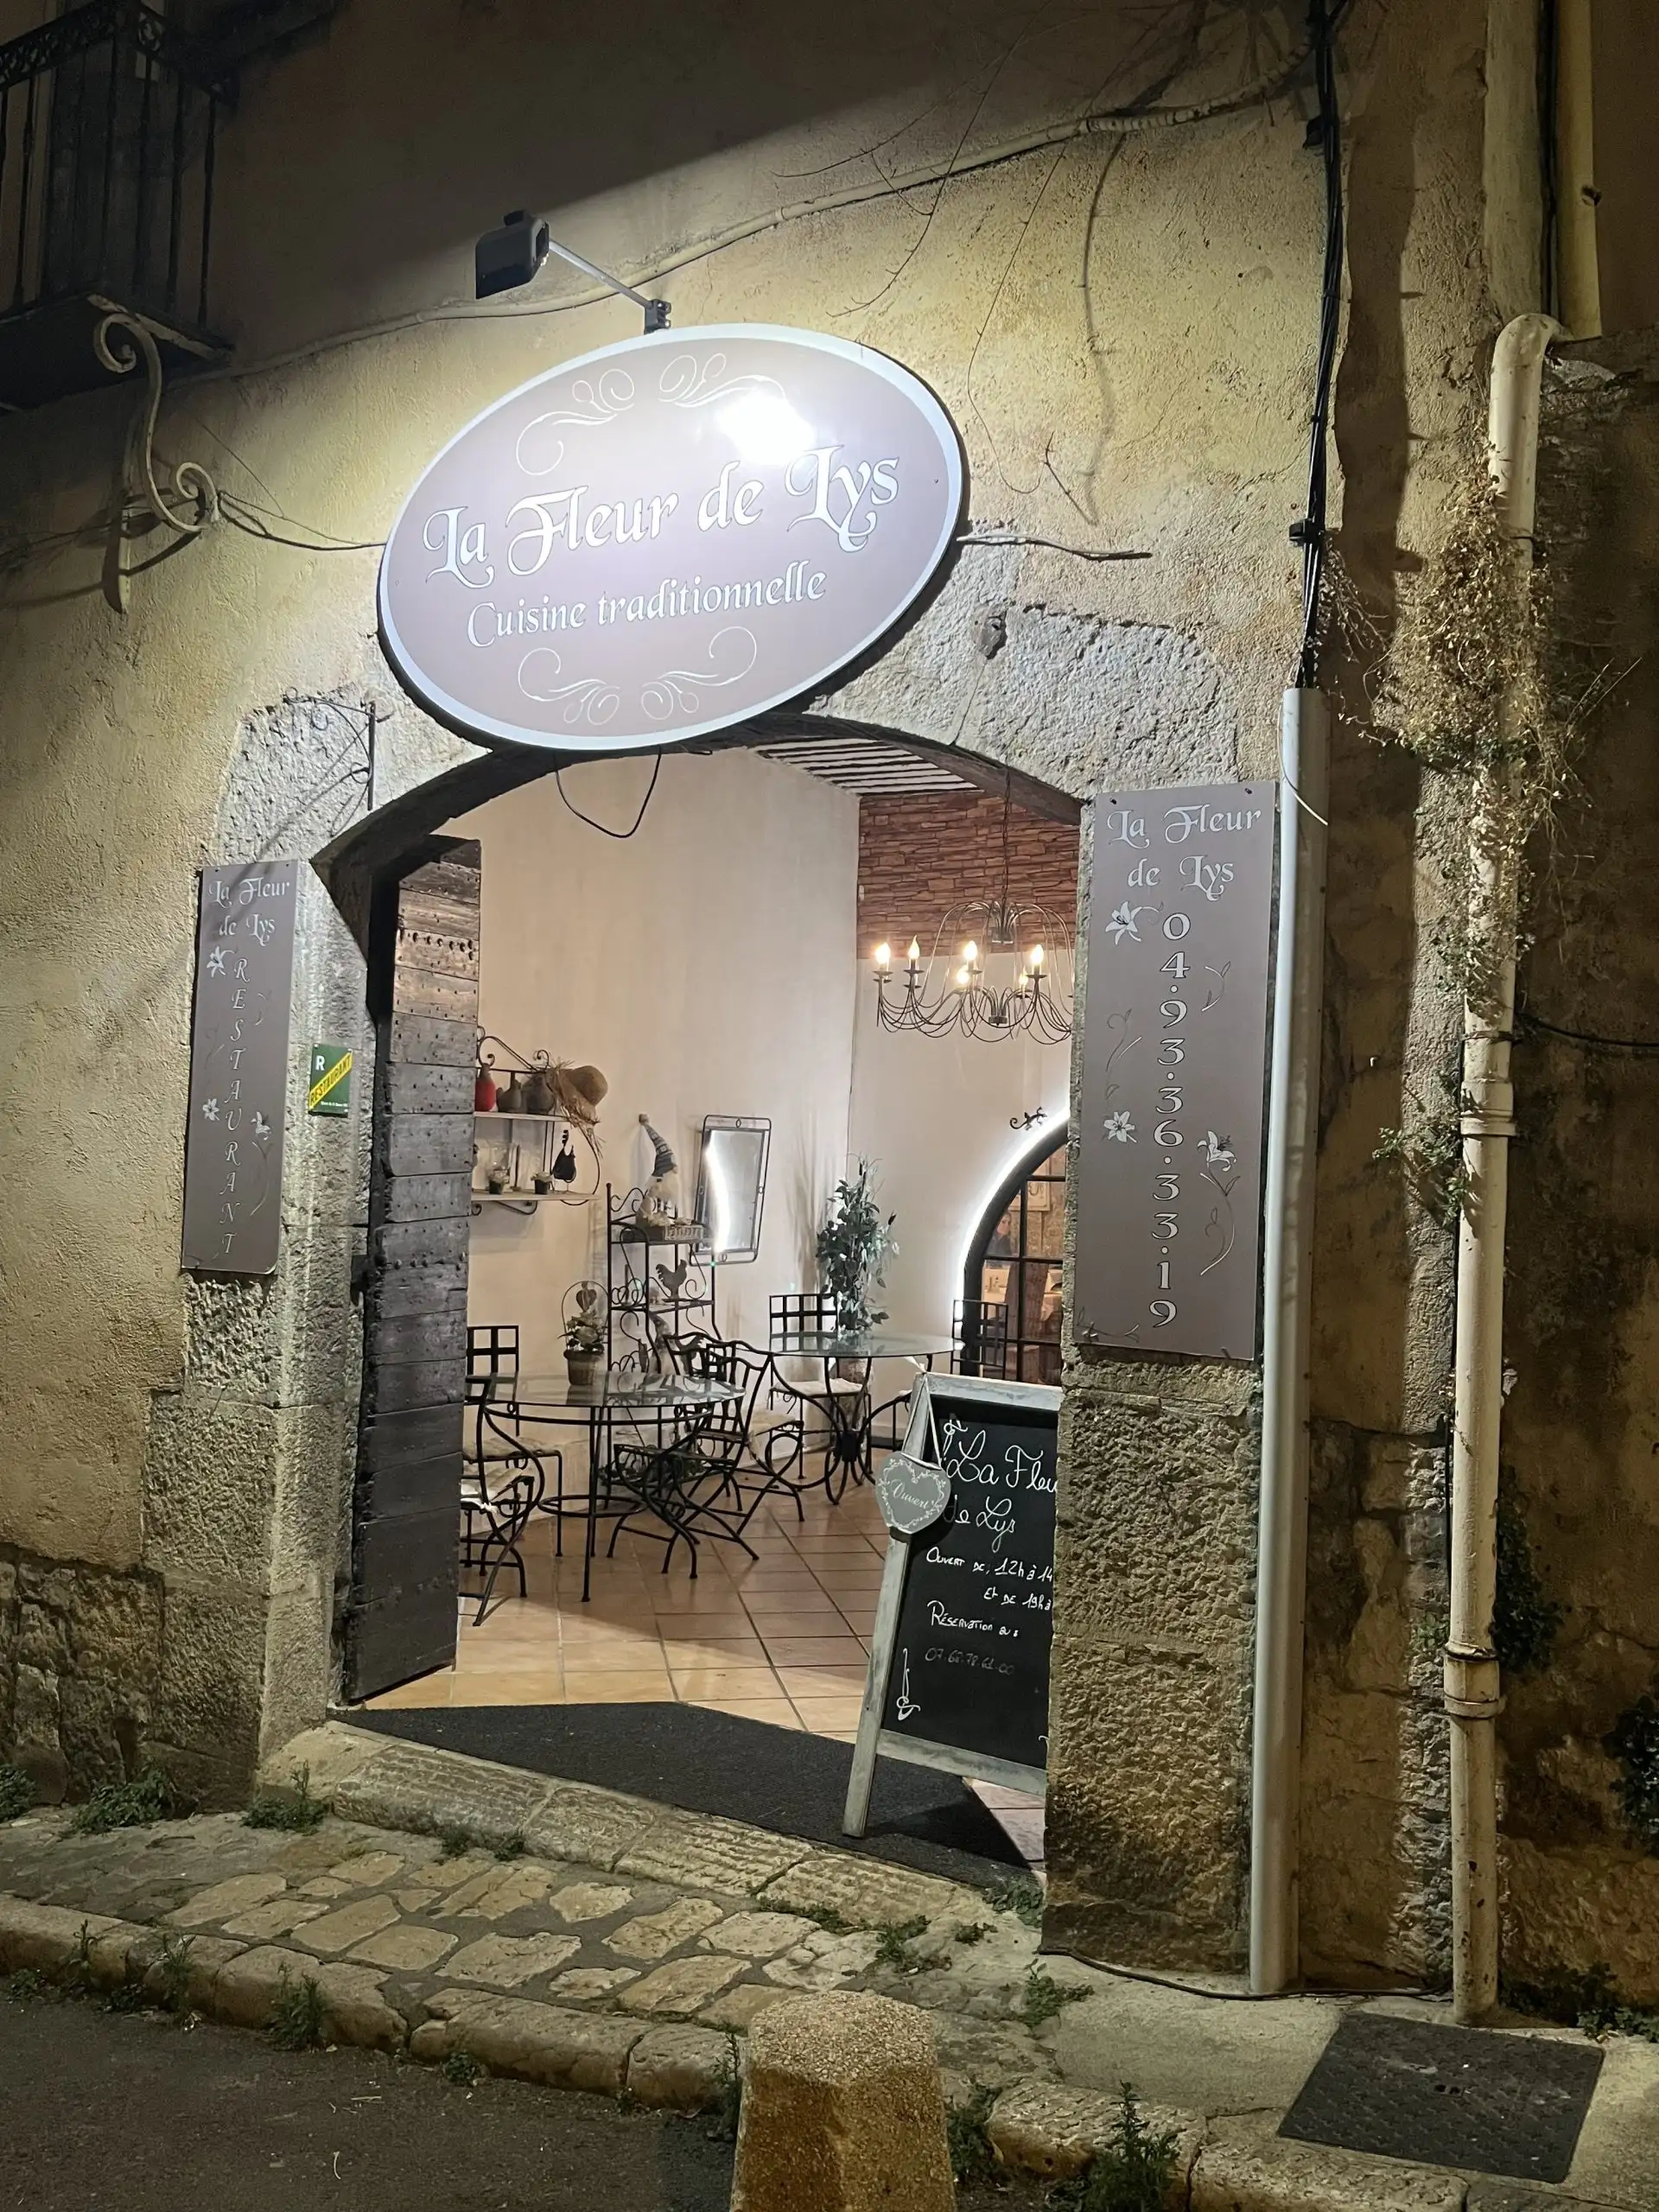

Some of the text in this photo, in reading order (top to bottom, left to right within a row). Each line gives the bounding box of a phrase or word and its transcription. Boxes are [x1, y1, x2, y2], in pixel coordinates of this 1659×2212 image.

[423, 444, 900, 589] La Fleur de Lys
[467, 560, 827, 649] Cuisine traditionnelle
[1107, 804, 1262, 849] La Fleur
[208, 877, 290, 908] La Fleur
[1127, 855, 1235, 901] de Lys
[219, 914, 276, 946] de Lys
[309, 1054, 352, 1104] RESTAURANT
[315, 1055, 325, 1071] R
[219, 958, 251, 1253] RESTAURANT
[947, 1430, 1056, 1492] La Fleu
[891, 1478, 930, 1510] Ouvert
[976, 1497, 1016, 1553] Lys
